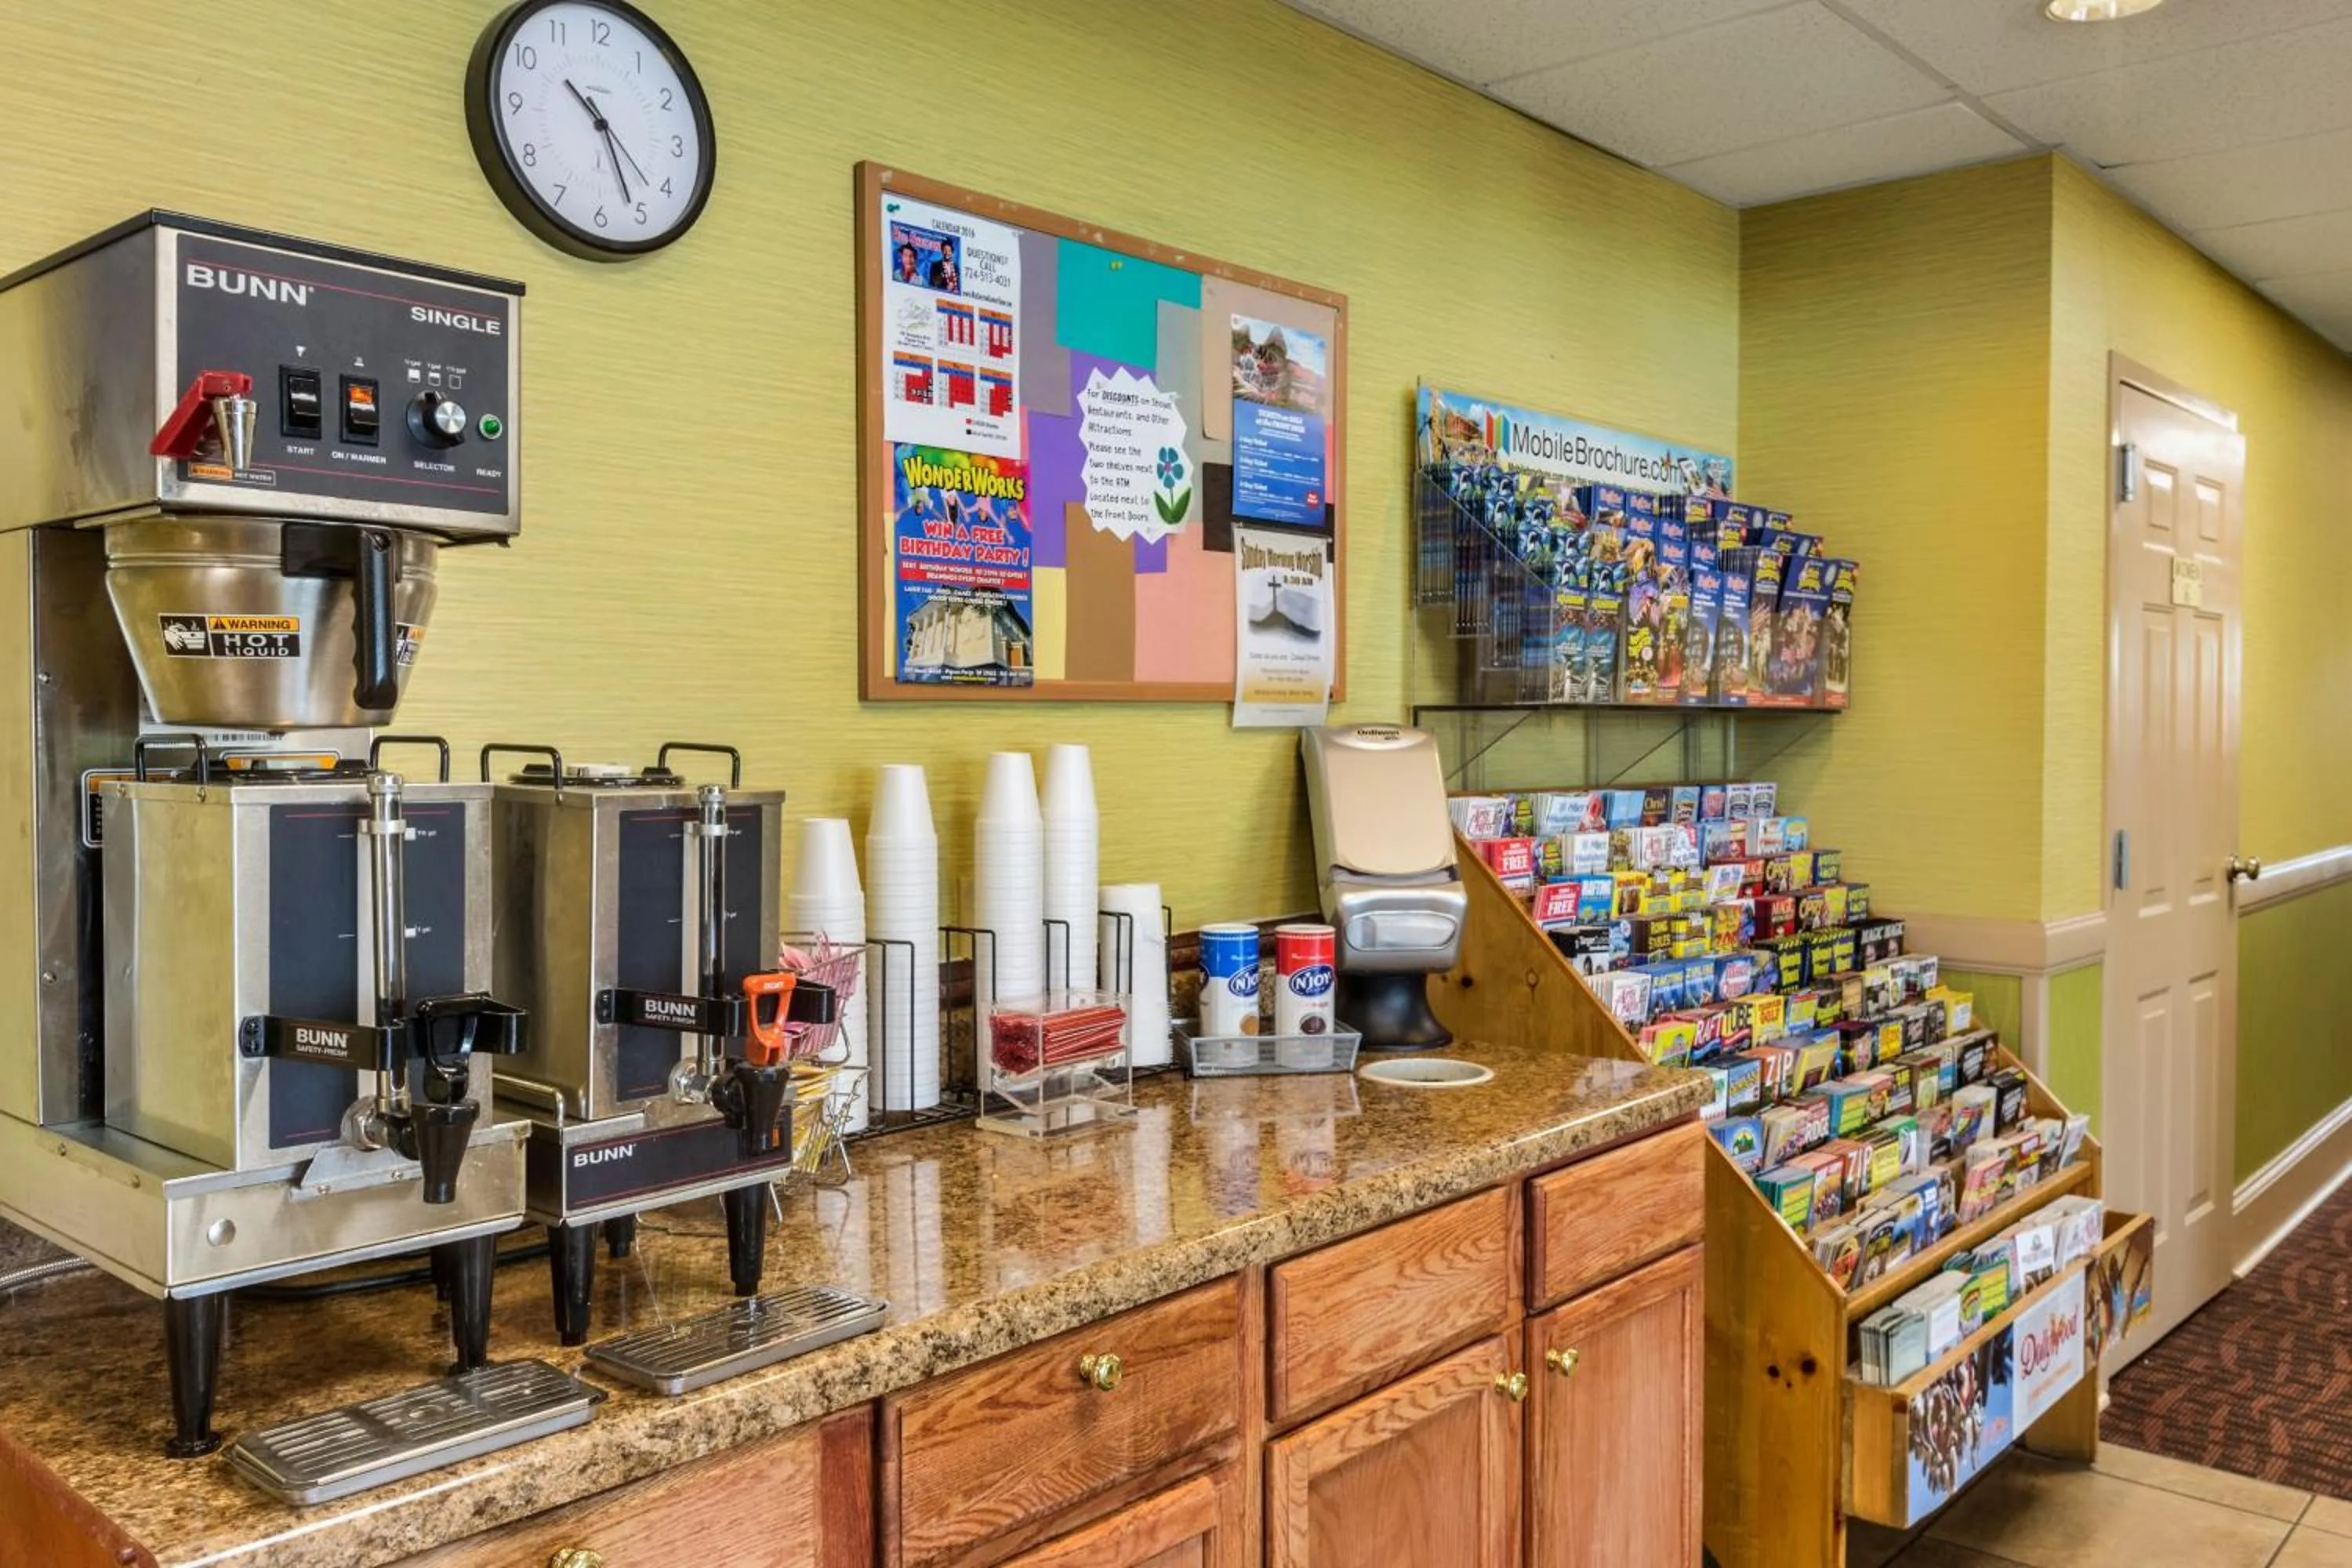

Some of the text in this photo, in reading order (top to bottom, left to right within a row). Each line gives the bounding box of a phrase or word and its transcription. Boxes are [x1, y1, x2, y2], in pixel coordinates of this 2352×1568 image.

[550, 20, 565, 45] 11
[591, 19, 611, 46] 12
[514, 43, 536, 70] 10
[636, 51, 641, 74] 1
[509, 92, 523, 115] 9
[659, 87, 673, 111] 2
[523, 143, 536, 167] 8
[671, 134, 684, 158] 3
[554, 184, 567, 205] 7
[659, 177, 673, 198] 4
[593, 205, 608, 228] 6
[635, 202, 648, 225] 5
[411, 307, 501, 336] SINGLE
[1087, 389, 1098, 397] For
[1102, 390, 1139, 405] DISCOUNTS
[286, 445, 314, 456] START
[1089, 442, 1111, 452] Please
[414, 461, 455, 472] SELECTOR
[476, 468, 503, 478] READY
[903, 456, 1025, 502] WONDERWORKS
[1116, 477, 1130, 487] ATM
[923, 519, 1004, 544] WIN A FREE
[899, 536, 973, 559] BIRTHDAY
[228, 619, 291, 630] WARNING
[224, 634, 289, 648] HOT
[225, 647, 289, 657] LIQUID
[1502, 855, 1528, 871] FREE
[1548, 900, 1574, 916] FREE
[645, 1000, 697, 1018] BUNN
[296, 1028, 348, 1048] BUNN
[573, 1146, 633, 1168] BUNN
